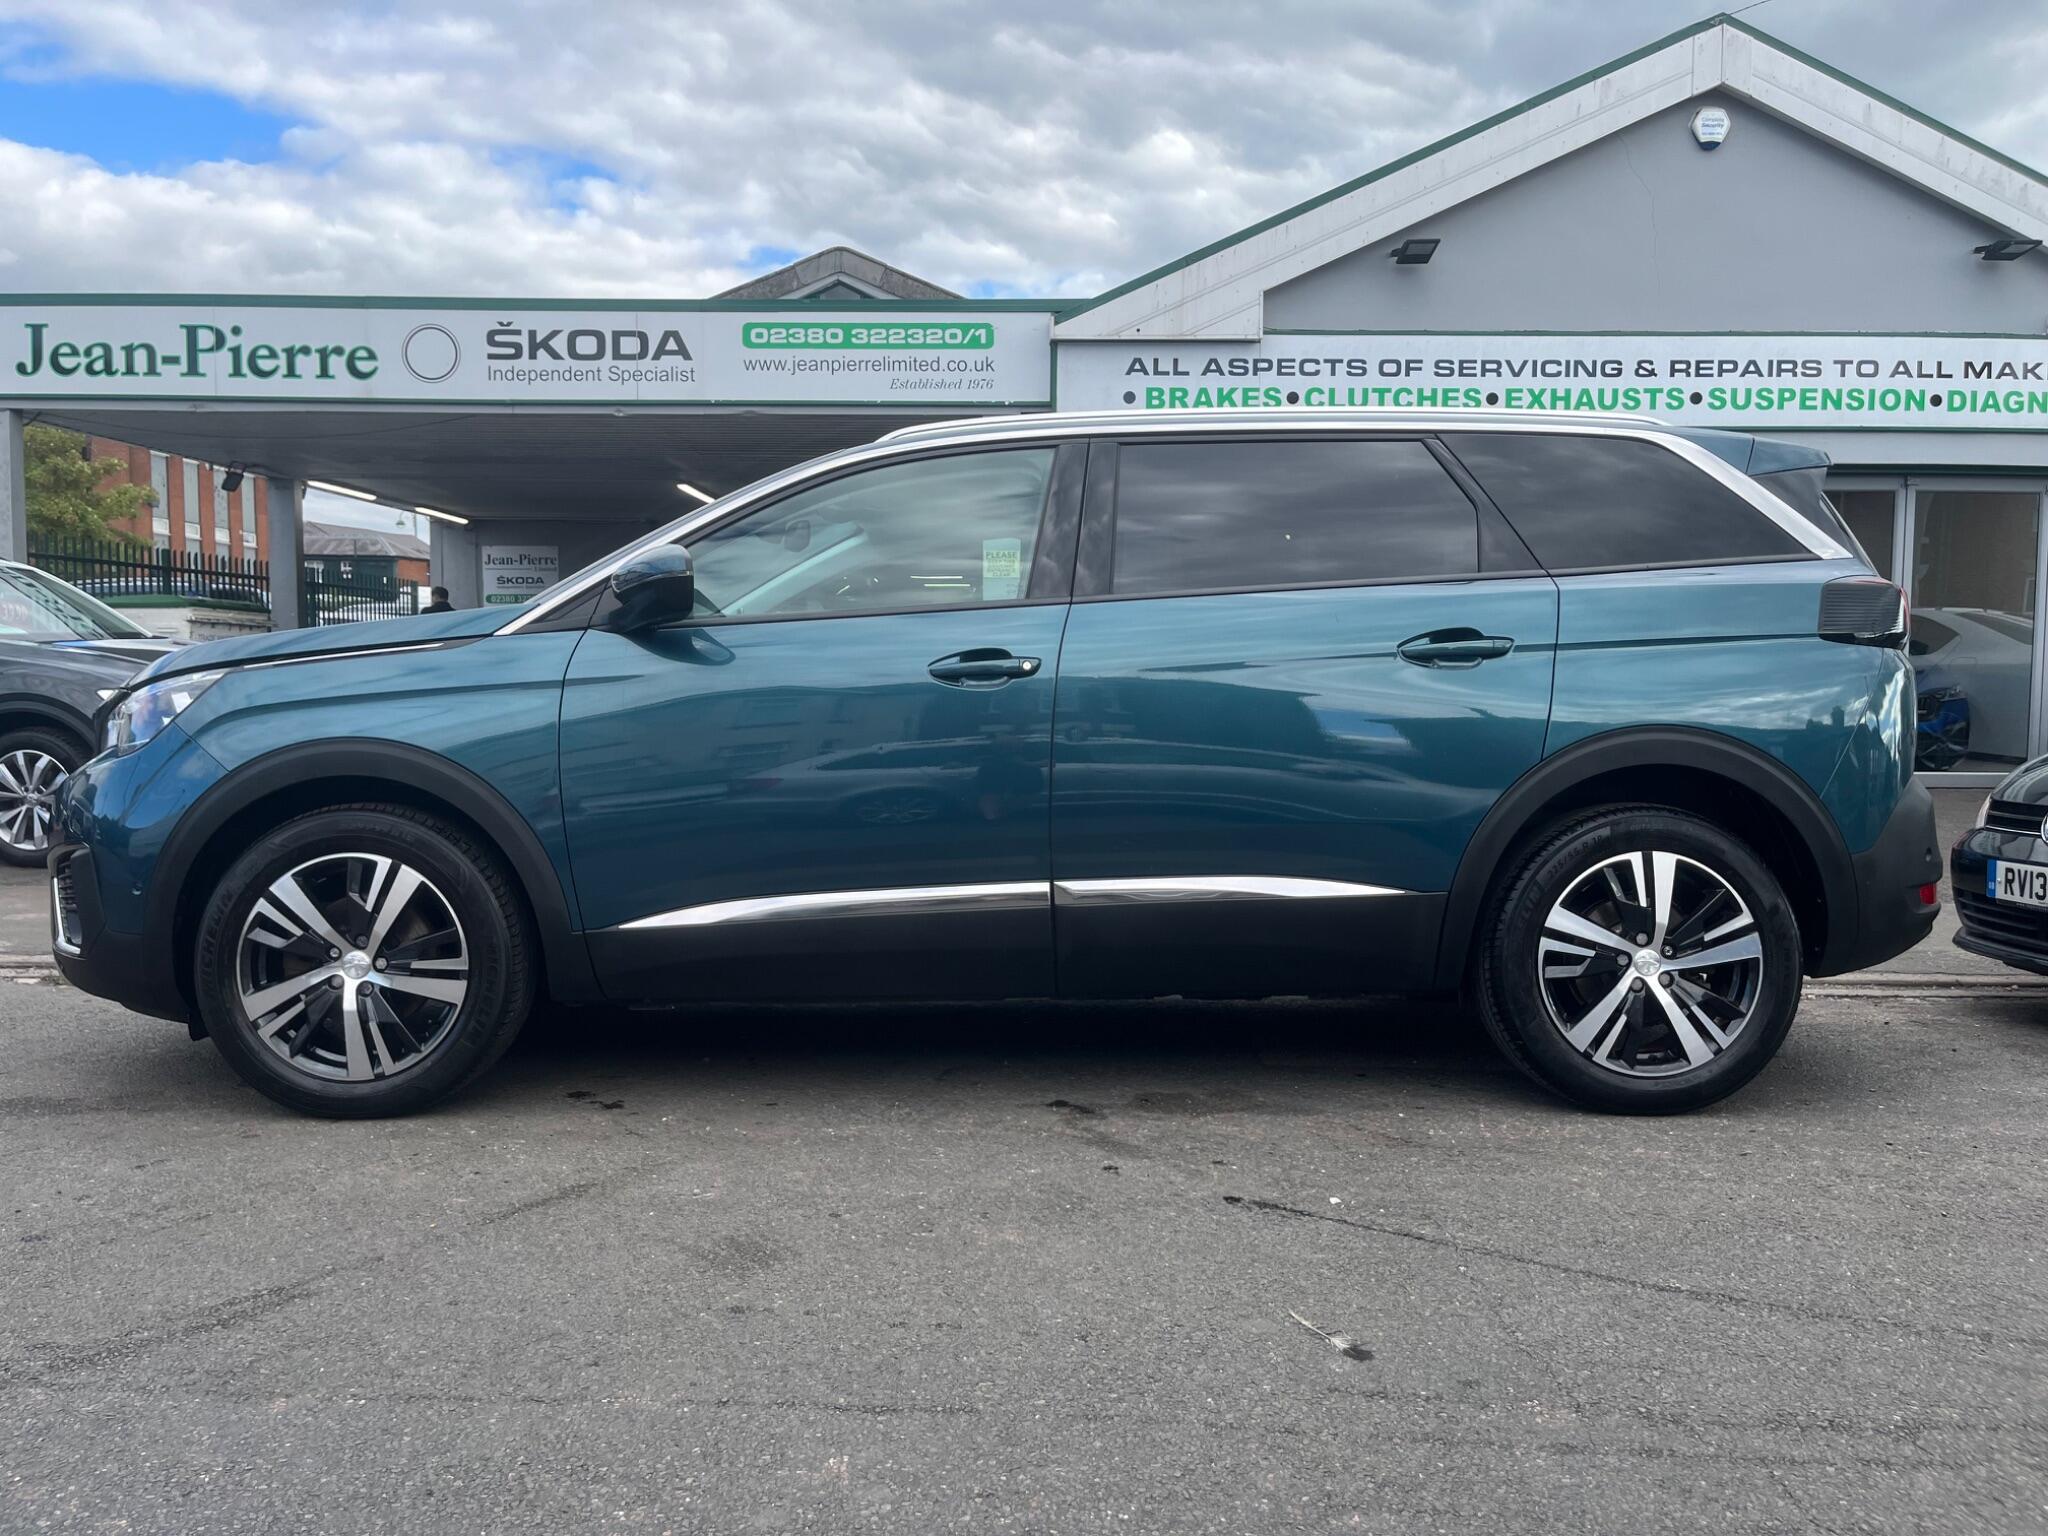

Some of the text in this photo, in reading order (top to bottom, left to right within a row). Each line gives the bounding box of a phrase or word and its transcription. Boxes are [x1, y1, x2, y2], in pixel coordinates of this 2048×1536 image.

[486, 321, 693, 361] ŠKODA
[750, 327, 988, 344] 02380 322320/1
[15, 323, 379, 380] Jean-Pierre
[744, 356, 996, 375] www.jeanpierrelimited.co.uk
[1125, 357, 2048, 380] ALL ASPECTS OF SERVICING & REPAIRS TO ALL MAK
[487, 366, 696, 385] Independent Specialist
[890, 378, 995, 390] Established 1976
[1145, 387, 2048, 413] BRAKES CLUTCHES EXHAUSTS SUSPENSION DIAGN
[485, 554, 557, 565] Jean-Pierre
[985, 551, 1017, 559] PLEASE
[497, 575, 544, 585] ŠKODA
[2004, 867, 2047, 901] RV13
